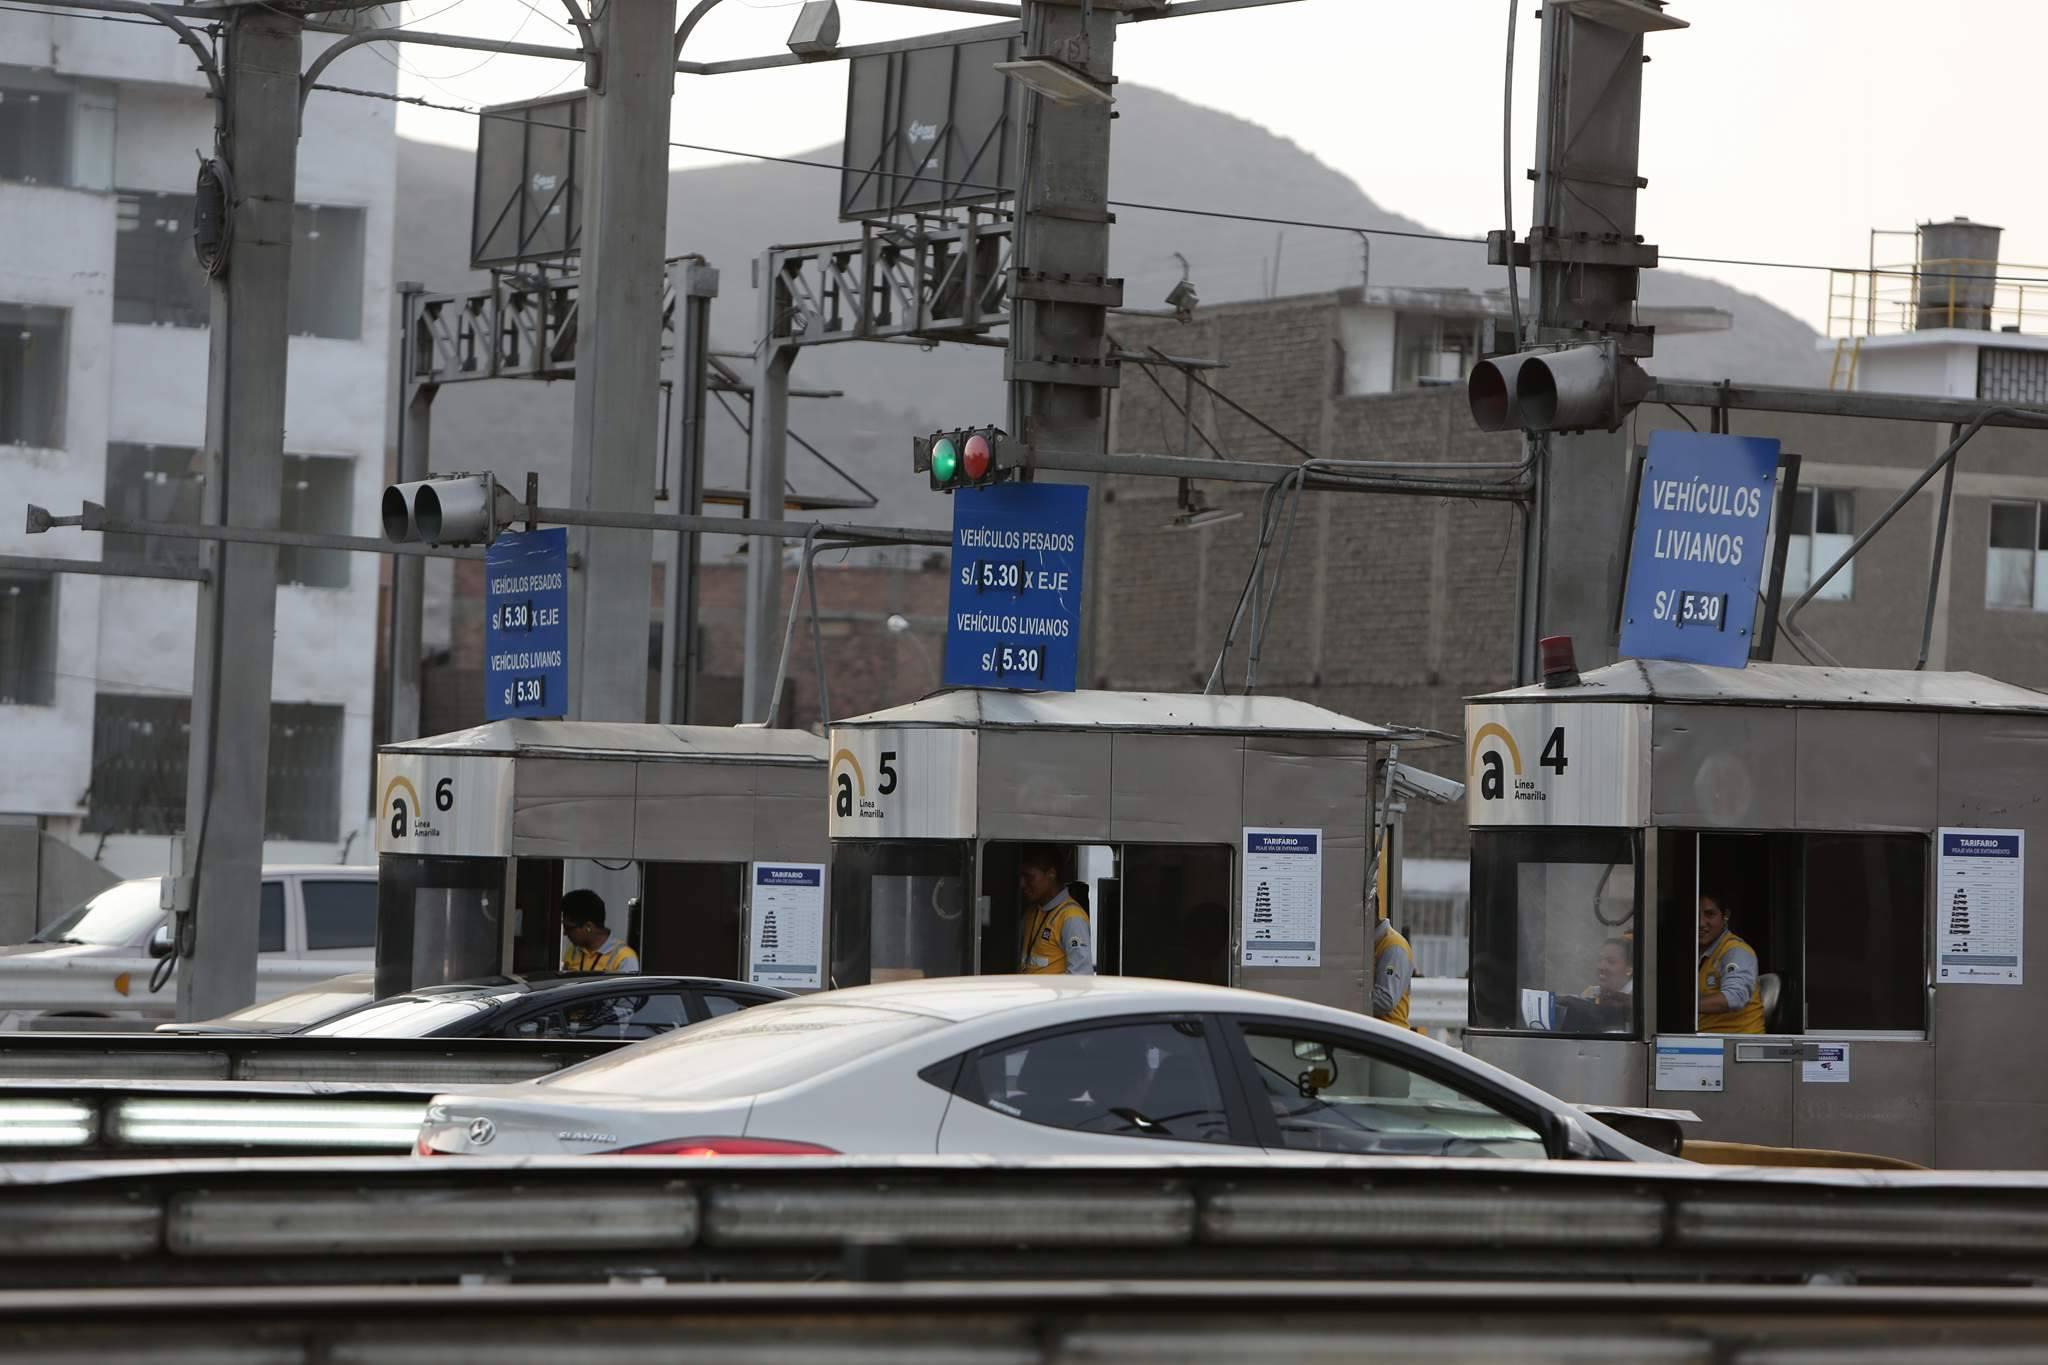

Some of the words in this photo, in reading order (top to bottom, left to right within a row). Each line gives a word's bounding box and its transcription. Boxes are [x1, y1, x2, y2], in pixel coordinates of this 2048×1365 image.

[1653, 475, 1761, 518] VEHÍCULOS
[960, 526, 1020, 549] VEHÍCULOS
[1022, 532, 1074, 552] PESADOS
[1654, 529, 1743, 566] LIVIANOS
[491, 574, 529, 594] VEHÍCULOS
[530, 573, 561, 592] PESADOS
[983, 564, 1018, 587] 5.30
[1038, 572, 1068, 591] EJE
[505, 605, 528, 627] 5.30
[540, 608, 559, 626] EJE
[1683, 595, 1719, 620] 5.30
[957, 610, 1017, 633] VEHÍCULOS
[1019, 617, 1069, 637] LIVIANOS
[491, 651, 529, 671] VEHÍCULOS
[530, 650, 561, 669] LIVIANOS
[1002, 648, 1038, 672] 5.30
[517, 680, 540, 701] 5.30
[1540, 727, 1568, 775] 4
[878, 751, 897, 795] 5
[1481, 750, 1504, 800] a
[435, 777, 453, 812] 6
[837, 773, 852, 818] a
[1514, 790, 1546, 801] Amarilla
[391, 798, 407, 838] a
[859, 809, 884, 819] Amarilla
[1264, 838, 1298, 846] TARIFARIO
[1960, 839, 1998, 848] TARIFARIO
[771, 871, 803, 879] TARIFARIO
